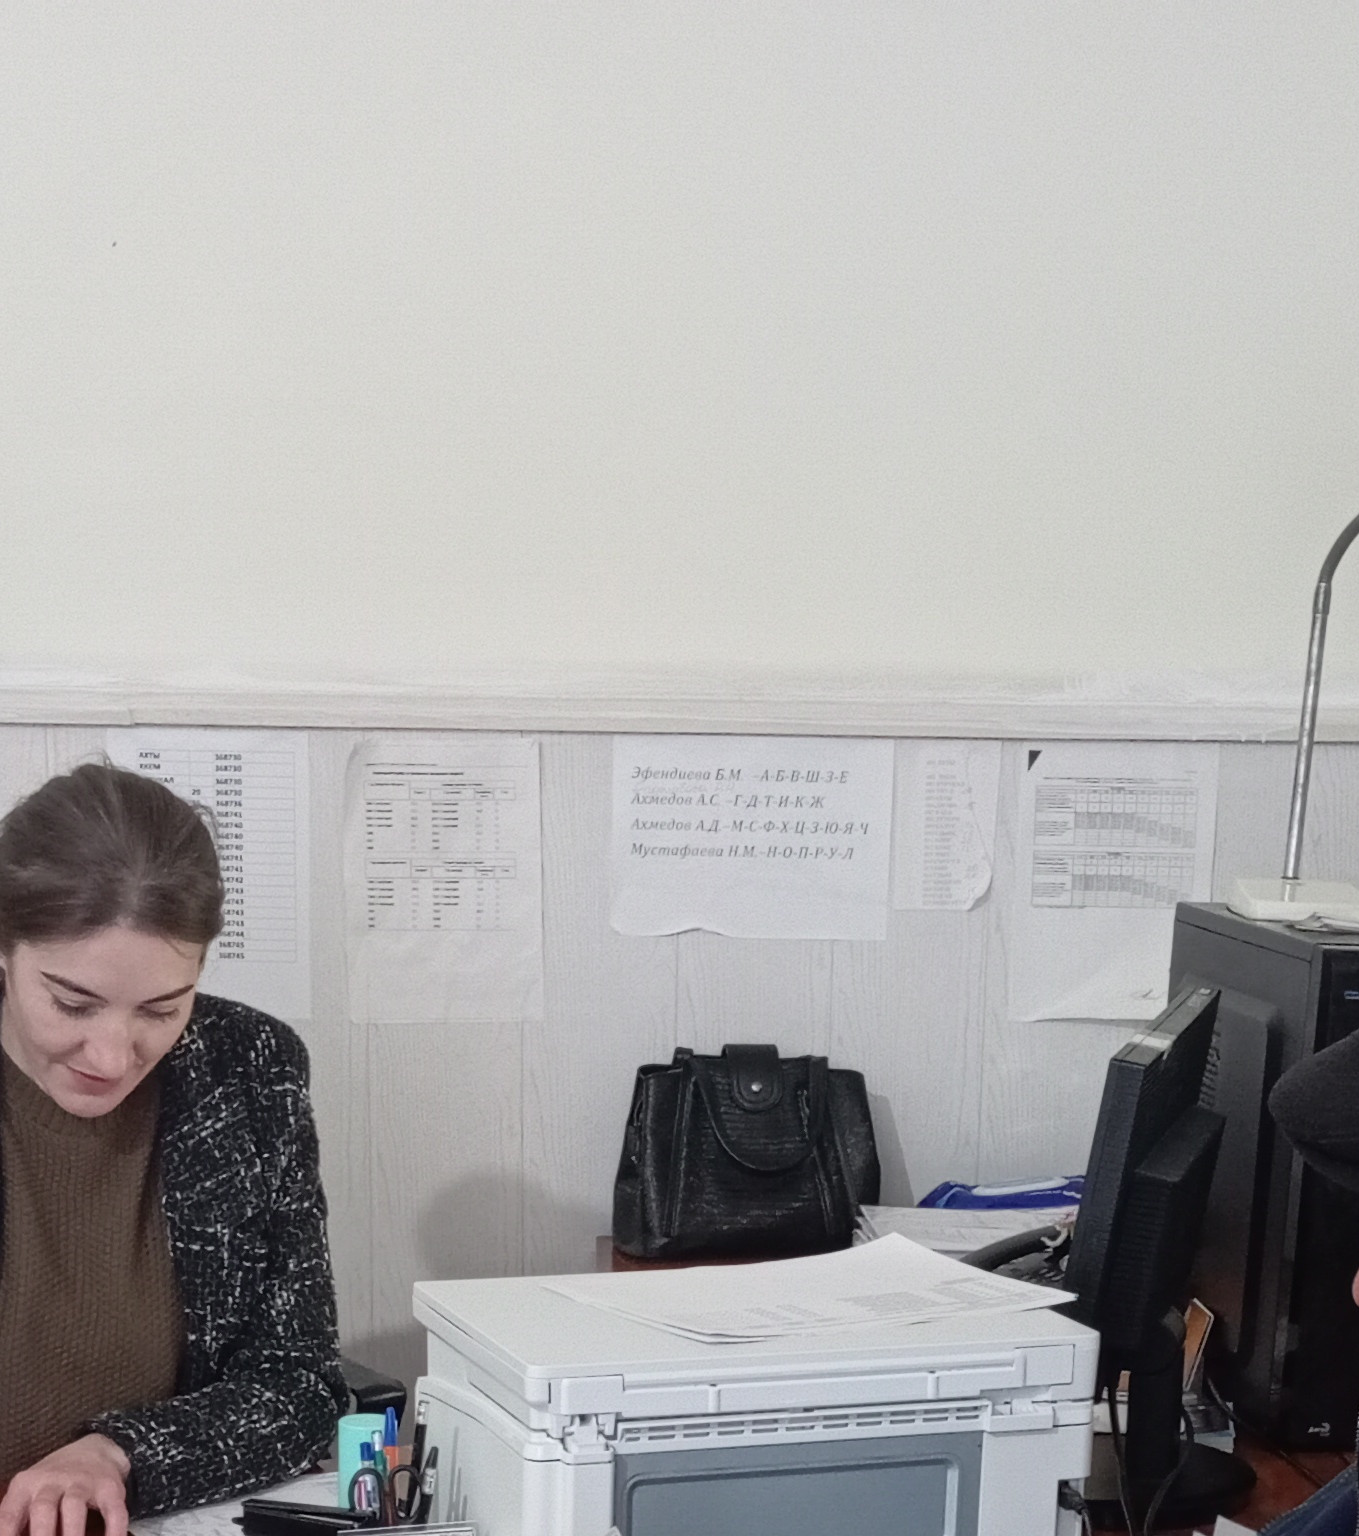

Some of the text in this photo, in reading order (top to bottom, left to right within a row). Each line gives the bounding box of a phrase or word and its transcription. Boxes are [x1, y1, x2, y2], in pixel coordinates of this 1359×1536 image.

[631, 766, 711, 782] Эфендиева
[630, 793, 693, 805] Ахмедов
[630, 818, 693, 831] Ахмедов
[630, 842, 724, 859] Мустафаева
